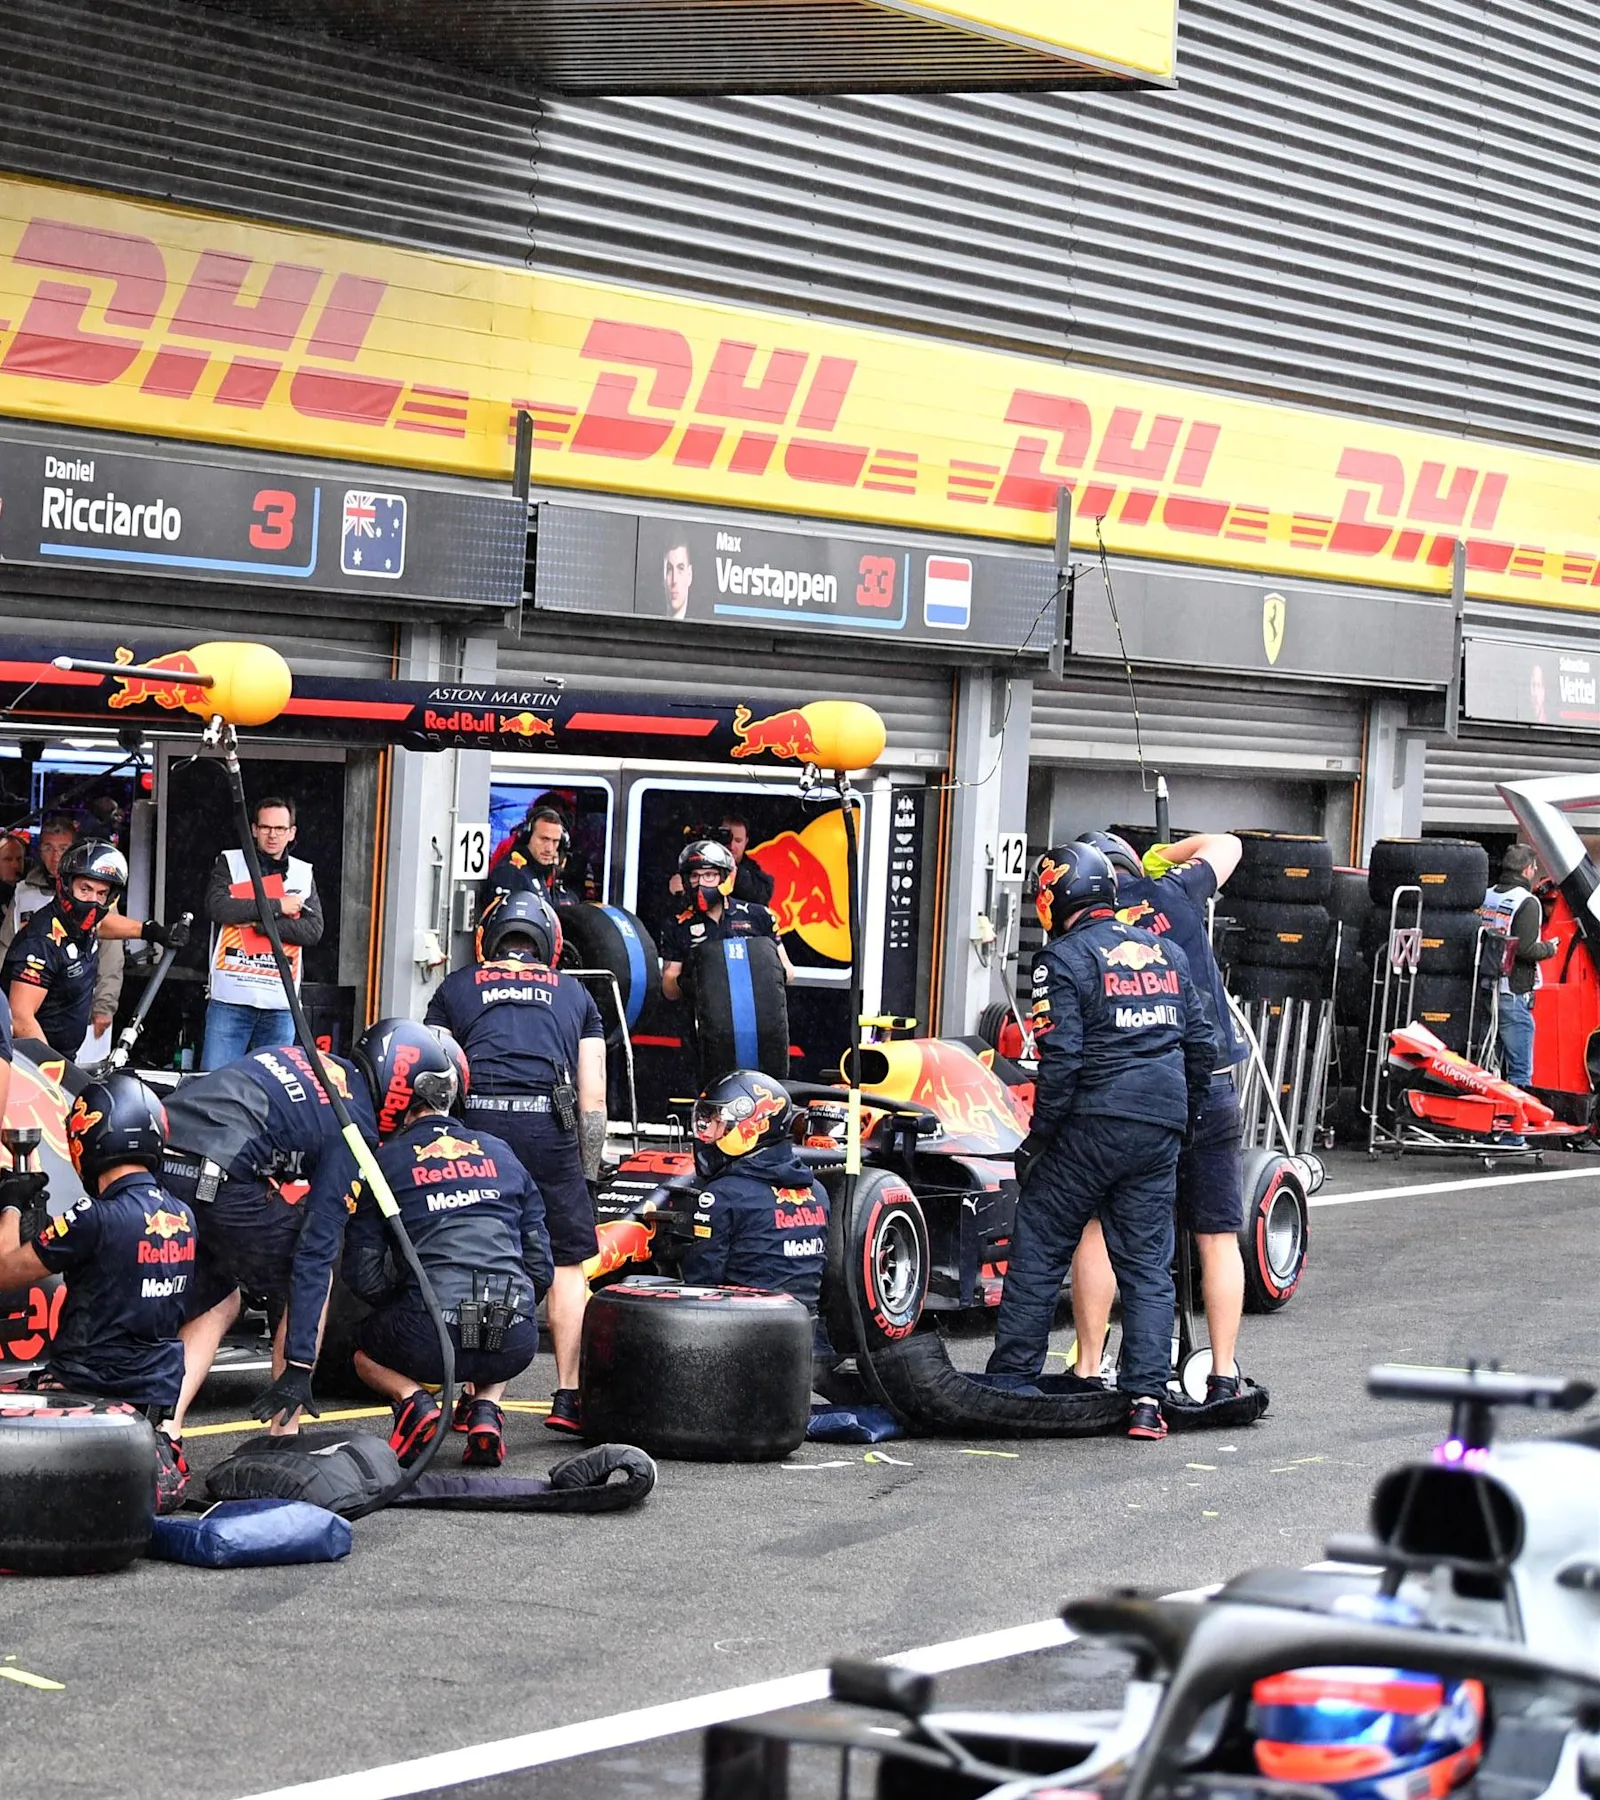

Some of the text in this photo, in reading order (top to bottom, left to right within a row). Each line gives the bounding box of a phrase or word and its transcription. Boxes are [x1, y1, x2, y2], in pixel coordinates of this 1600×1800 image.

[569, 318, 871, 488] DHL
[45, 455, 95, 485] Daniel
[994, 389, 1230, 536] DHL
[41, 486, 182, 542] Ricciardo
[250, 489, 296, 550] 3
[1328, 447, 1515, 574] DHL
[716, 531, 741, 553] Max
[715, 556, 837, 605] Verstappen
[856, 555, 896, 607] 33
[428, 687, 561, 706] ASTON MARTIN
[1559, 675, 1596, 704] Vettel
[424, 710, 495, 733] Red Bull
[427, 732, 559, 750] RACING
[460, 830, 485, 873] 13
[1001, 838, 1024, 875] 12
[253, 953, 276, 962] LAN
[475, 969, 560, 987] Red Bull
[1103, 970, 1179, 997] Red Bull
[481, 986, 533, 1005] Mobil
[1115, 1004, 1166, 1028] Mobil
[253, 1052, 298, 1084] Mobil
[379, 1045, 421, 1132] Red Bull
[412, 1158, 498, 1186] Red Bull
[426, 1188, 480, 1212] Mobil
[774, 1205, 826, 1229] Red Bull
[137, 1237, 195, 1264] Red Bull
[783, 1238, 817, 1257] Mobil
[141, 1278, 174, 1298] Mob
